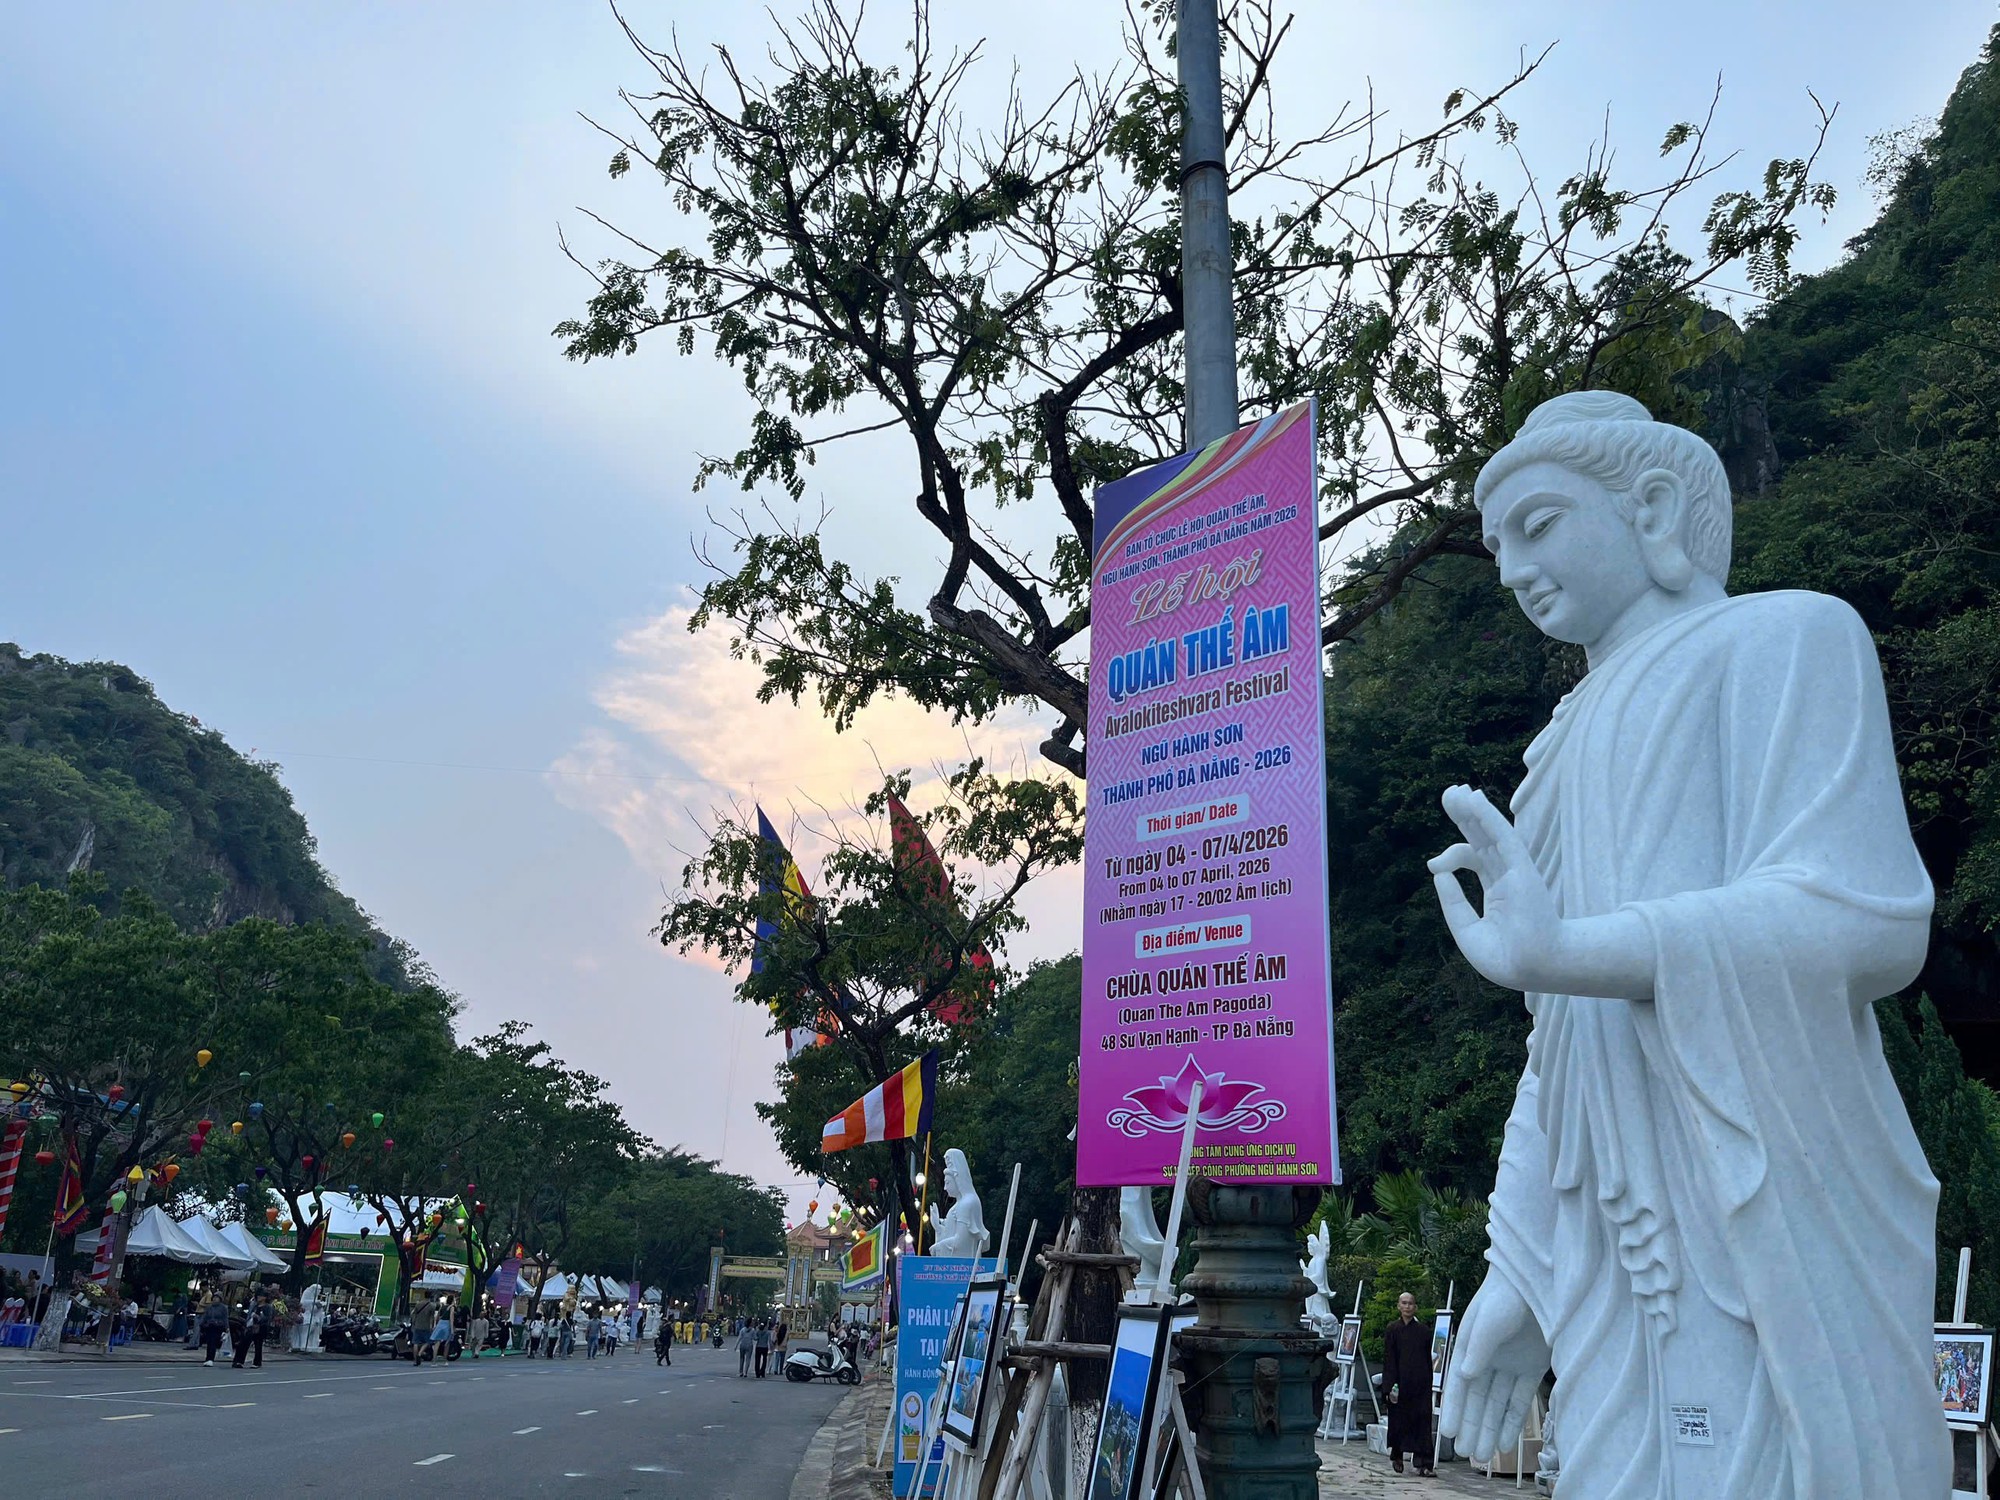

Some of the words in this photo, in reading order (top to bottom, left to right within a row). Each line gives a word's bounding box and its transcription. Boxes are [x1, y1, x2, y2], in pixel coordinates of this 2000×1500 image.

[1119, 562, 1140, 580] HÀNH
[1142, 555, 1160, 572] SƠN,
[1163, 543, 1189, 564] THÀNH
[1191, 532, 1208, 554] PHỐ
[1210, 530, 1222, 547] ĐÀ
[1250, 514, 1272, 532] NĂM
[1274, 505, 1297, 524] 2026
[1126, 543, 1142, 557] BAN
[1190, 518, 1204, 535] HỘI
[1232, 496, 1248, 518] THẾ
[1250, 494, 1267, 510] ÂM,
[1126, 570, 1193, 626] Lễ
[1188, 548, 1263, 604] hội
[1108, 638, 1176, 704] QUÁN
[1183, 604, 1235, 679] THẾ
[1240, 602, 1290, 664] ÂM
[1104, 688, 1221, 739] Avalokiteshvara
[1226, 666, 1290, 706] Festival
[1142, 742, 1168, 766] NGŨ
[1172, 732, 1210, 758] HÀNH
[1214, 723, 1244, 748] SƠN
[1103, 778, 1144, 806] THÀNH
[1147, 766, 1174, 796] PHỐ
[1177, 764, 1196, 788] ĐÀ
[1254, 745, 1292, 771] 2026
[1147, 814, 1171, 834] Thời
[1175, 807, 1205, 830] gian/
[1209, 802, 1238, 821] Date
[1105, 856, 1122, 879] Từ
[1126, 849, 1162, 875] ngày
[1166, 844, 1186, 866] 04
[1202, 824, 1288, 860] 07/4/2026
[1119, 880, 1146, 898] From
[1150, 876, 1164, 892] 04
[1168, 874, 1178, 889] to
[1182, 870, 1196, 886] 07
[1200, 864, 1234, 884] April,
[1238, 857, 1270, 877] 2026
[1099, 903, 1135, 924] (Nhằm
[1139, 898, 1167, 917] ngày
[1171, 896, 1185, 912] 17
[1197, 888, 1232, 907] 20/02
[1236, 881, 1257, 901] Âm
[1261, 878, 1292, 901] lịch)
[1142, 932, 1162, 953] Địa
[1166, 925, 1201, 947] điểm/
[1204, 924, 1243, 941] Venue
[1106, 968, 1152, 1000] CHÙA
[1157, 961, 1207, 996] QUÁN
[1212, 950, 1249, 987] THẾ
[1253, 952, 1287, 982] ÂM
[1118, 1008, 1155, 1026] (Quan
[1158, 1003, 1182, 1019] The
[1186, 1000, 1208, 1016] Am
[1213, 993, 1272, 1014] Pagoda)
[1101, 1034, 1116, 1050] 48
[1119, 1031, 1135, 1049] Sư
[1139, 1031, 1162, 1050] Vạn
[1166, 1027, 1199, 1048] Hạnh
[1212, 1024, 1228, 1040] TP
[1233, 1022, 1251, 1039] Đà
[1256, 1016, 1294, 1037] Nẵng
[1224, 1145, 1245, 1157] CUNG
[1265, 1144, 1283, 1158] DỊCH
[1285, 1144, 1296, 1158] VỤ
[1225, 1162, 1256, 1176] PHƯỜNG
[1300, 1162, 1318, 1176] SƠN
[908, 1305, 941, 1326] PHÂN
[920, 1338, 938, 1360] TẠI
